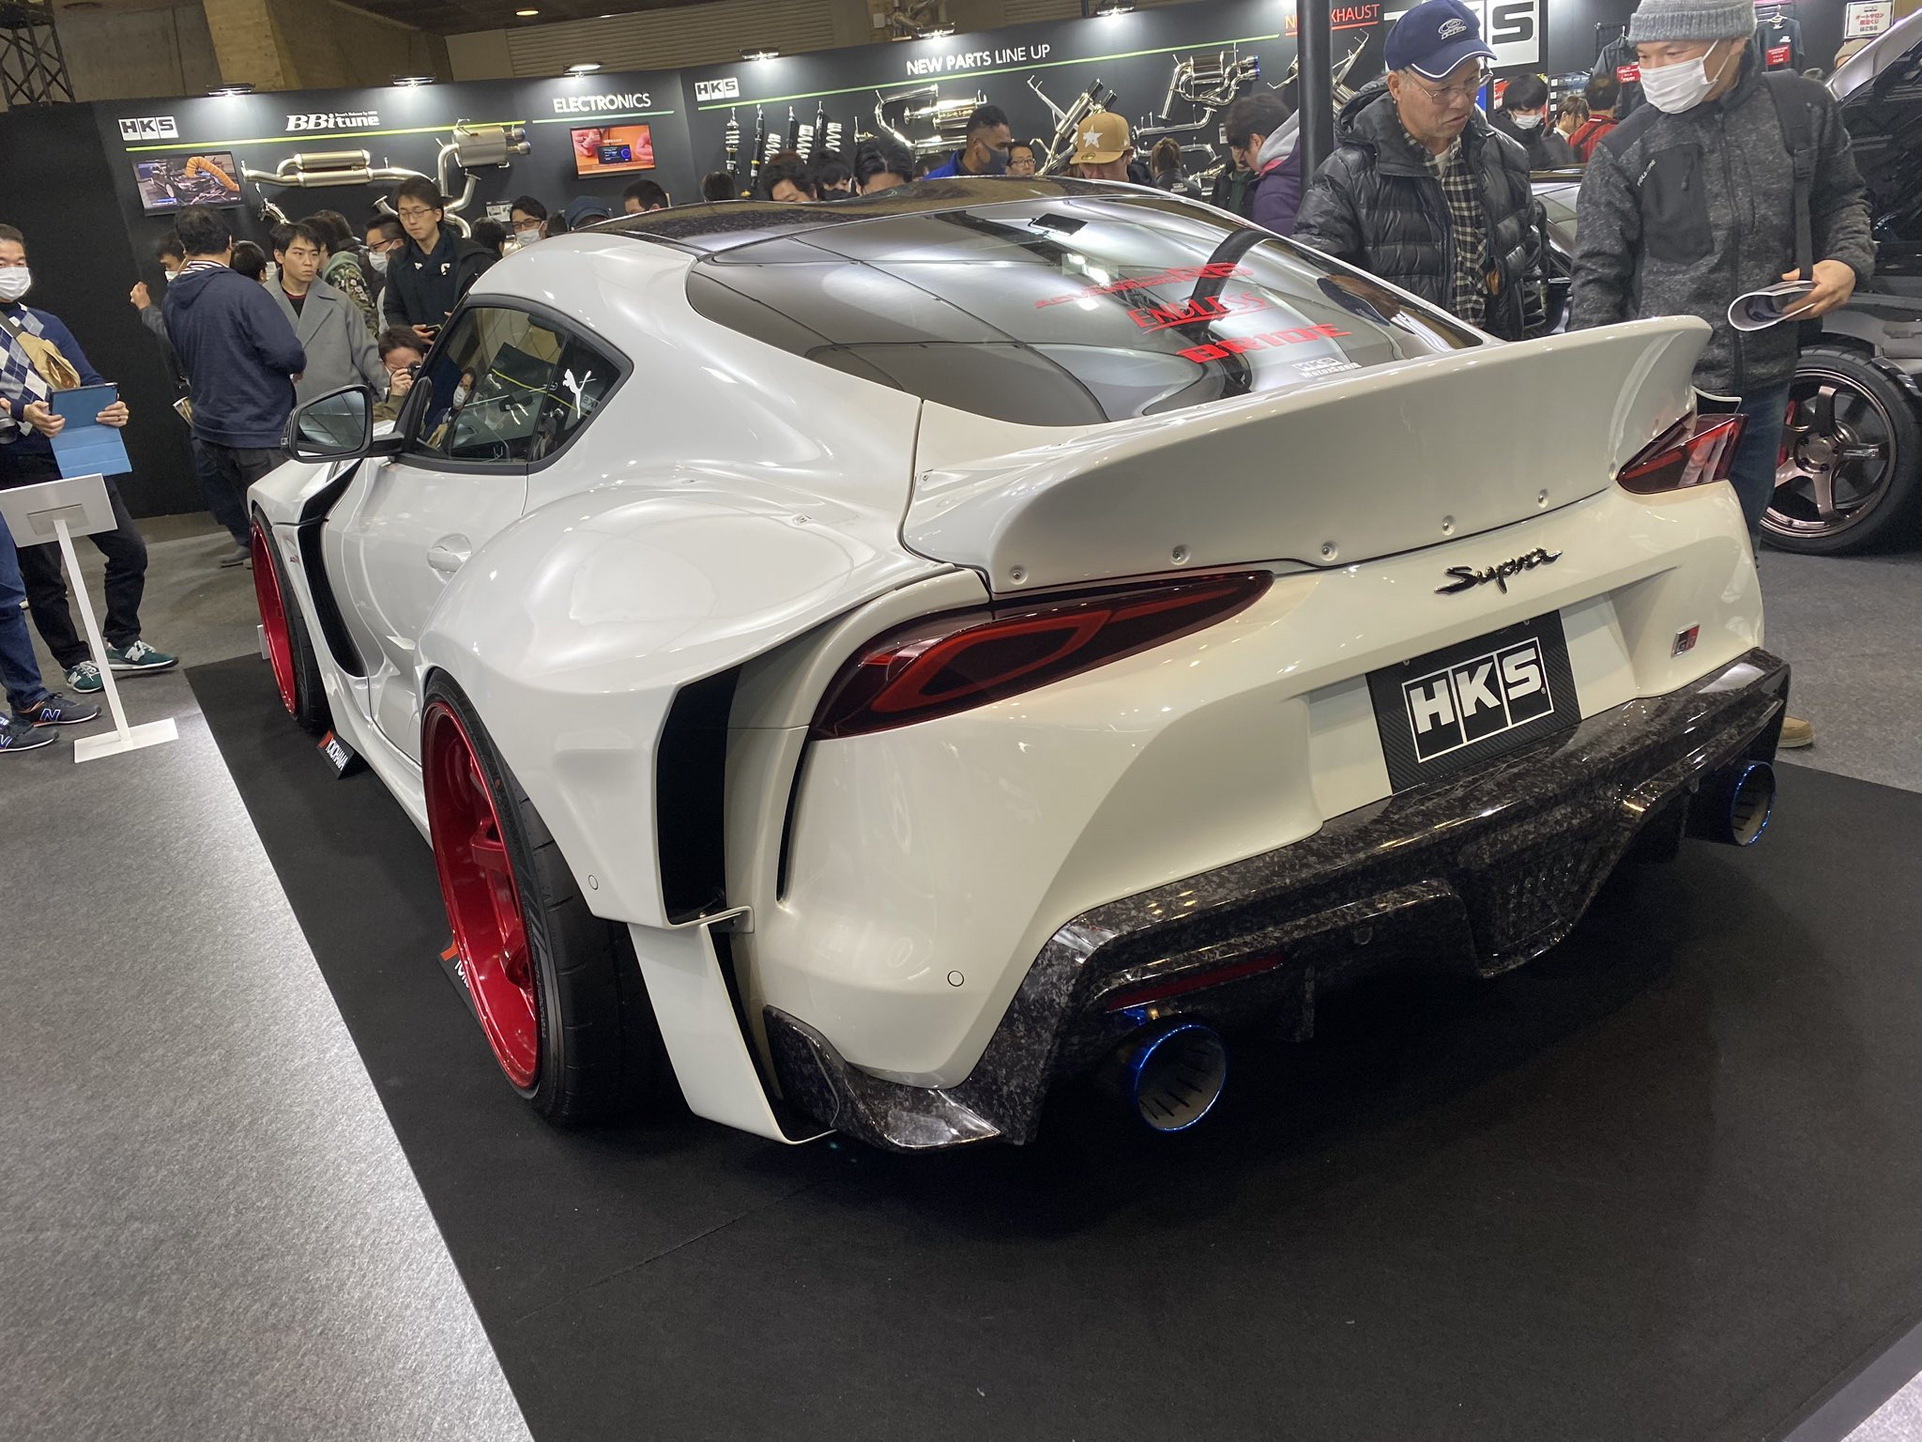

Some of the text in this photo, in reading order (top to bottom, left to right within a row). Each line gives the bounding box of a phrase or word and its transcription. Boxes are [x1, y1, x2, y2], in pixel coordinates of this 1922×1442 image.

[1331, 3, 1380, 23] XHAUST
[906, 43, 1051, 76] NEW PARTS LINE UP
[552, 93, 652, 114] ELECTRONICS
[696, 79, 737, 97] HKS
[120, 117, 175, 136] HKS
[1126, 292, 1268, 330] ENDLESS
[1177, 323, 1352, 363] BRIDE
[1433, 546, 1563, 594] Supra
[1406, 643, 1546, 742] HKS
